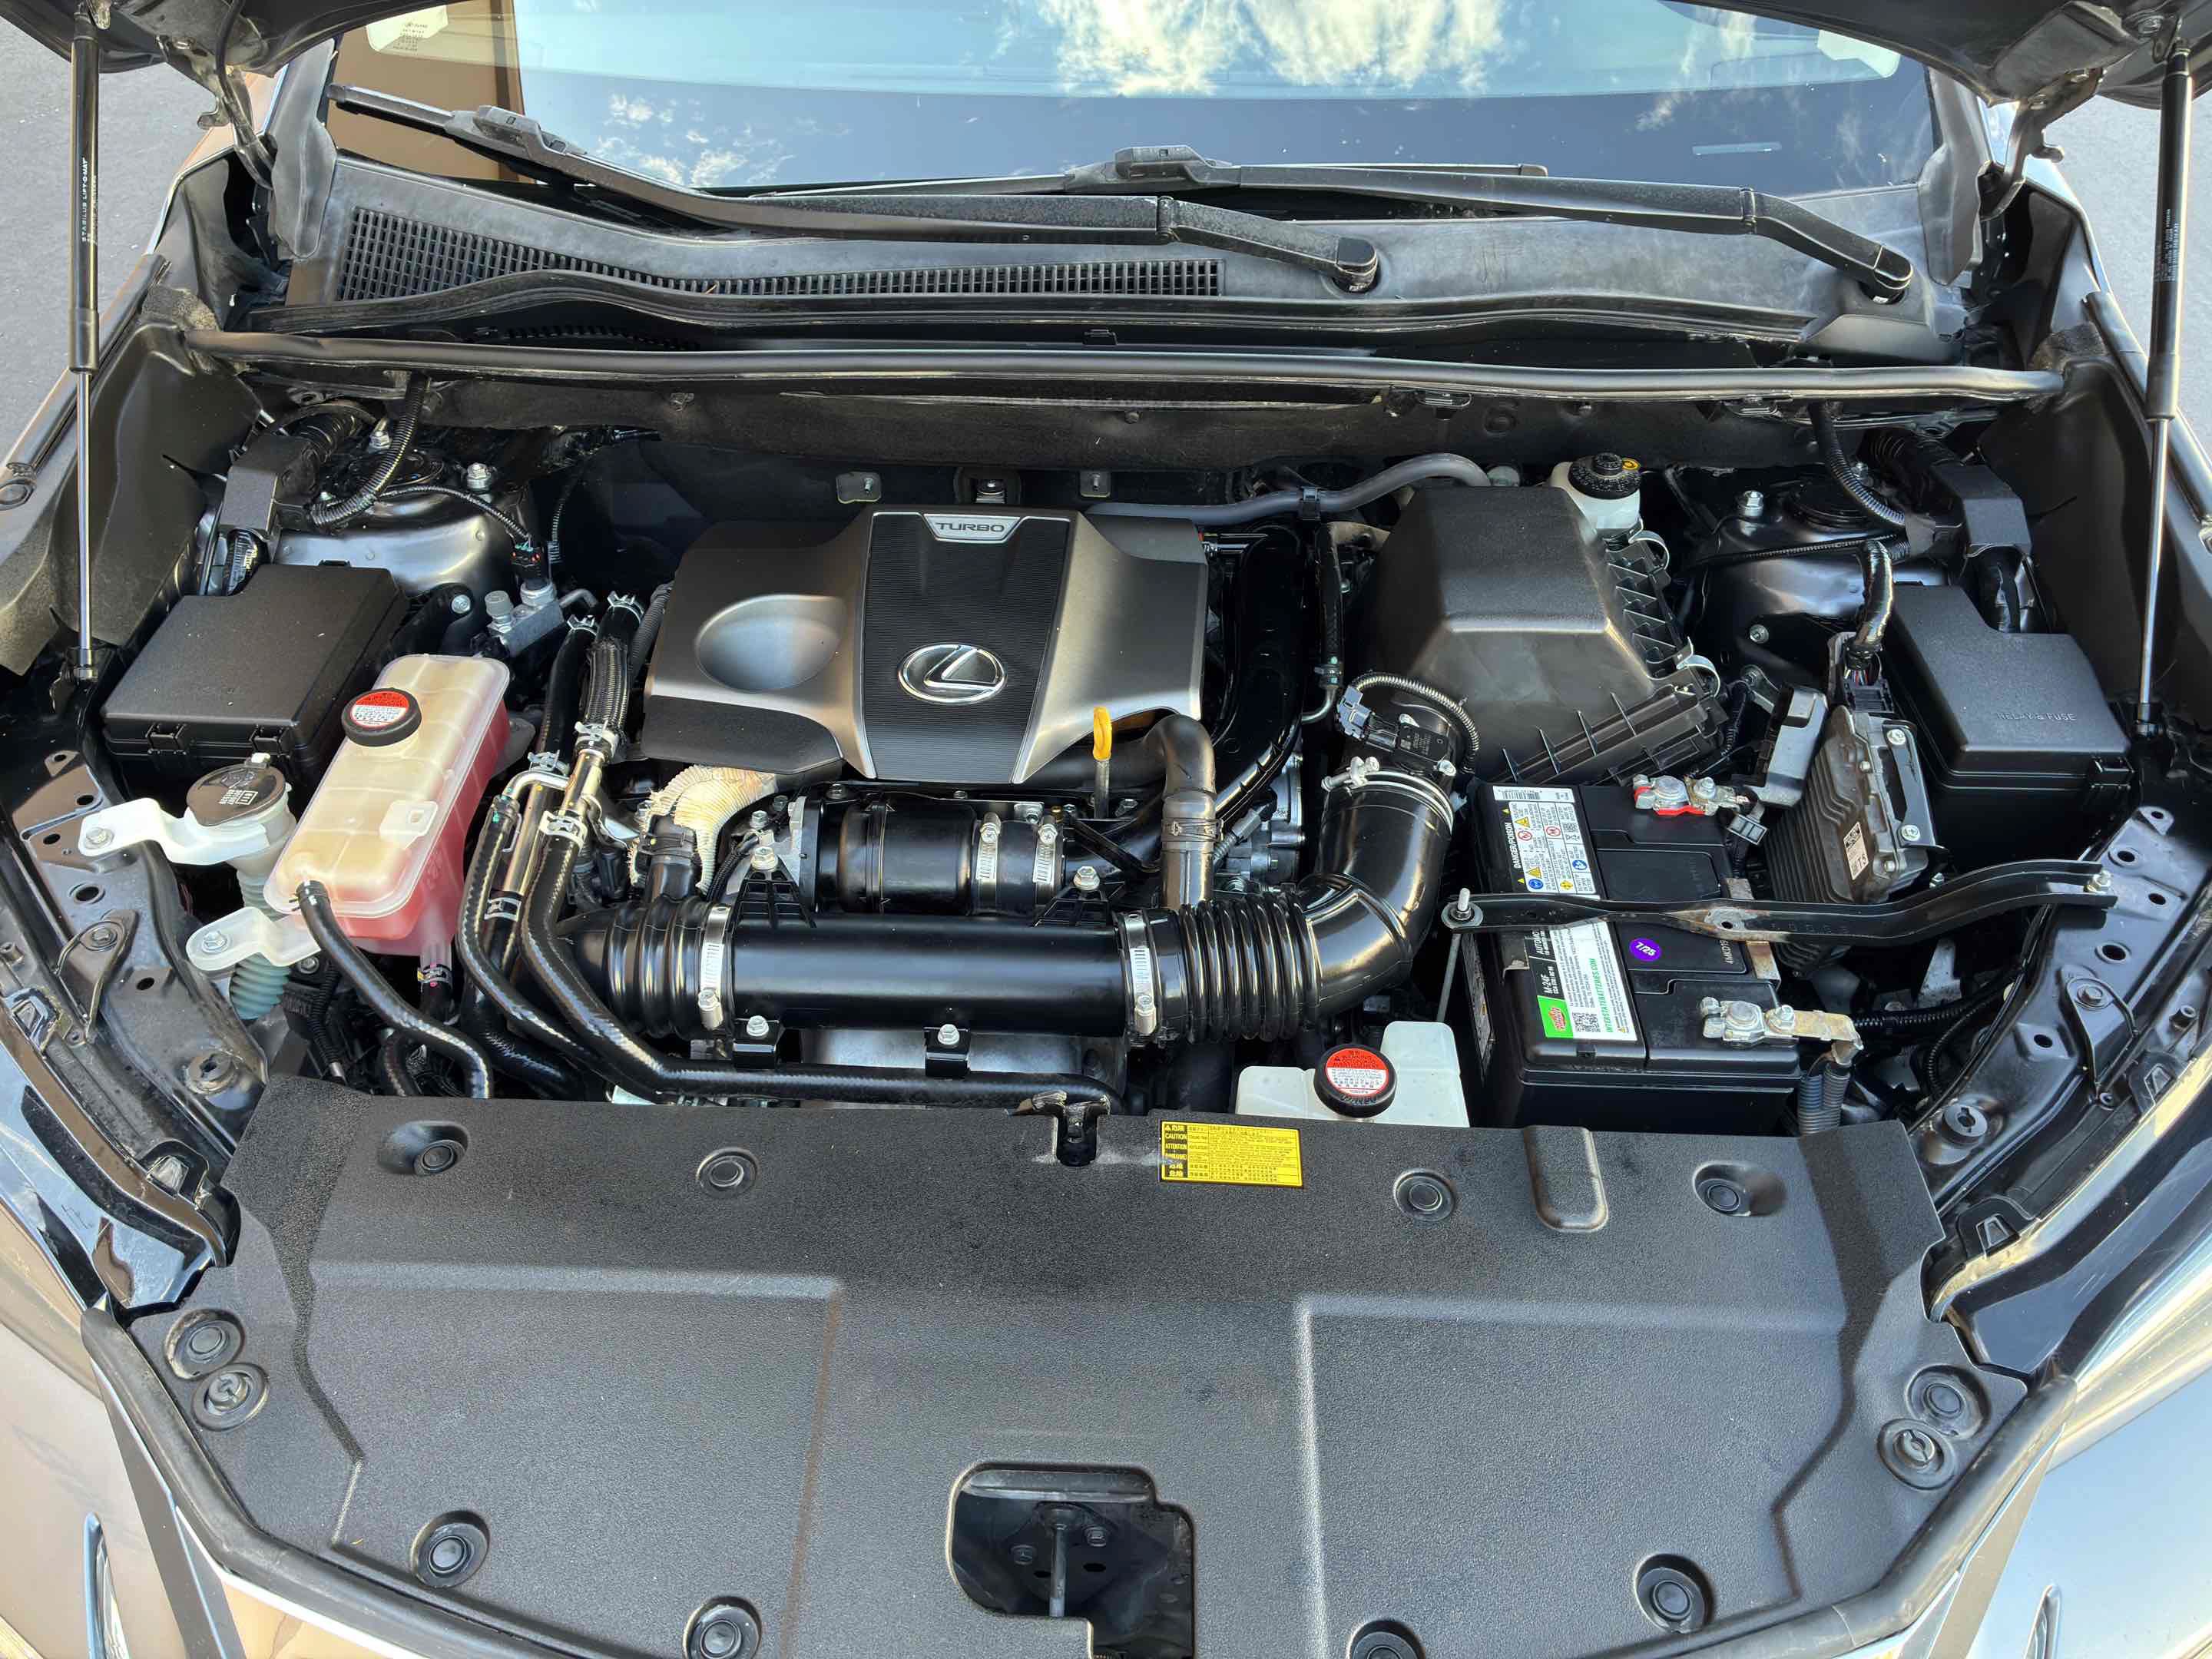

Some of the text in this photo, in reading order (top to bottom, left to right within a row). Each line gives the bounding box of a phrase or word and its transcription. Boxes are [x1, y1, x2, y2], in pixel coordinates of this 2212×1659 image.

[935, 522, 1005, 532] TURBO
[1996, 712, 2034, 720] RELAY
[2046, 713, 2078, 721] FUSE
[1505, 821, 1522, 869] DANGER/POISON
[1634, 941, 1657, 956] 7/25
[1540, 973, 1552, 993] M-24F
[1588, 957, 1614, 1032] INTERSTATEBATTERIES.COM
